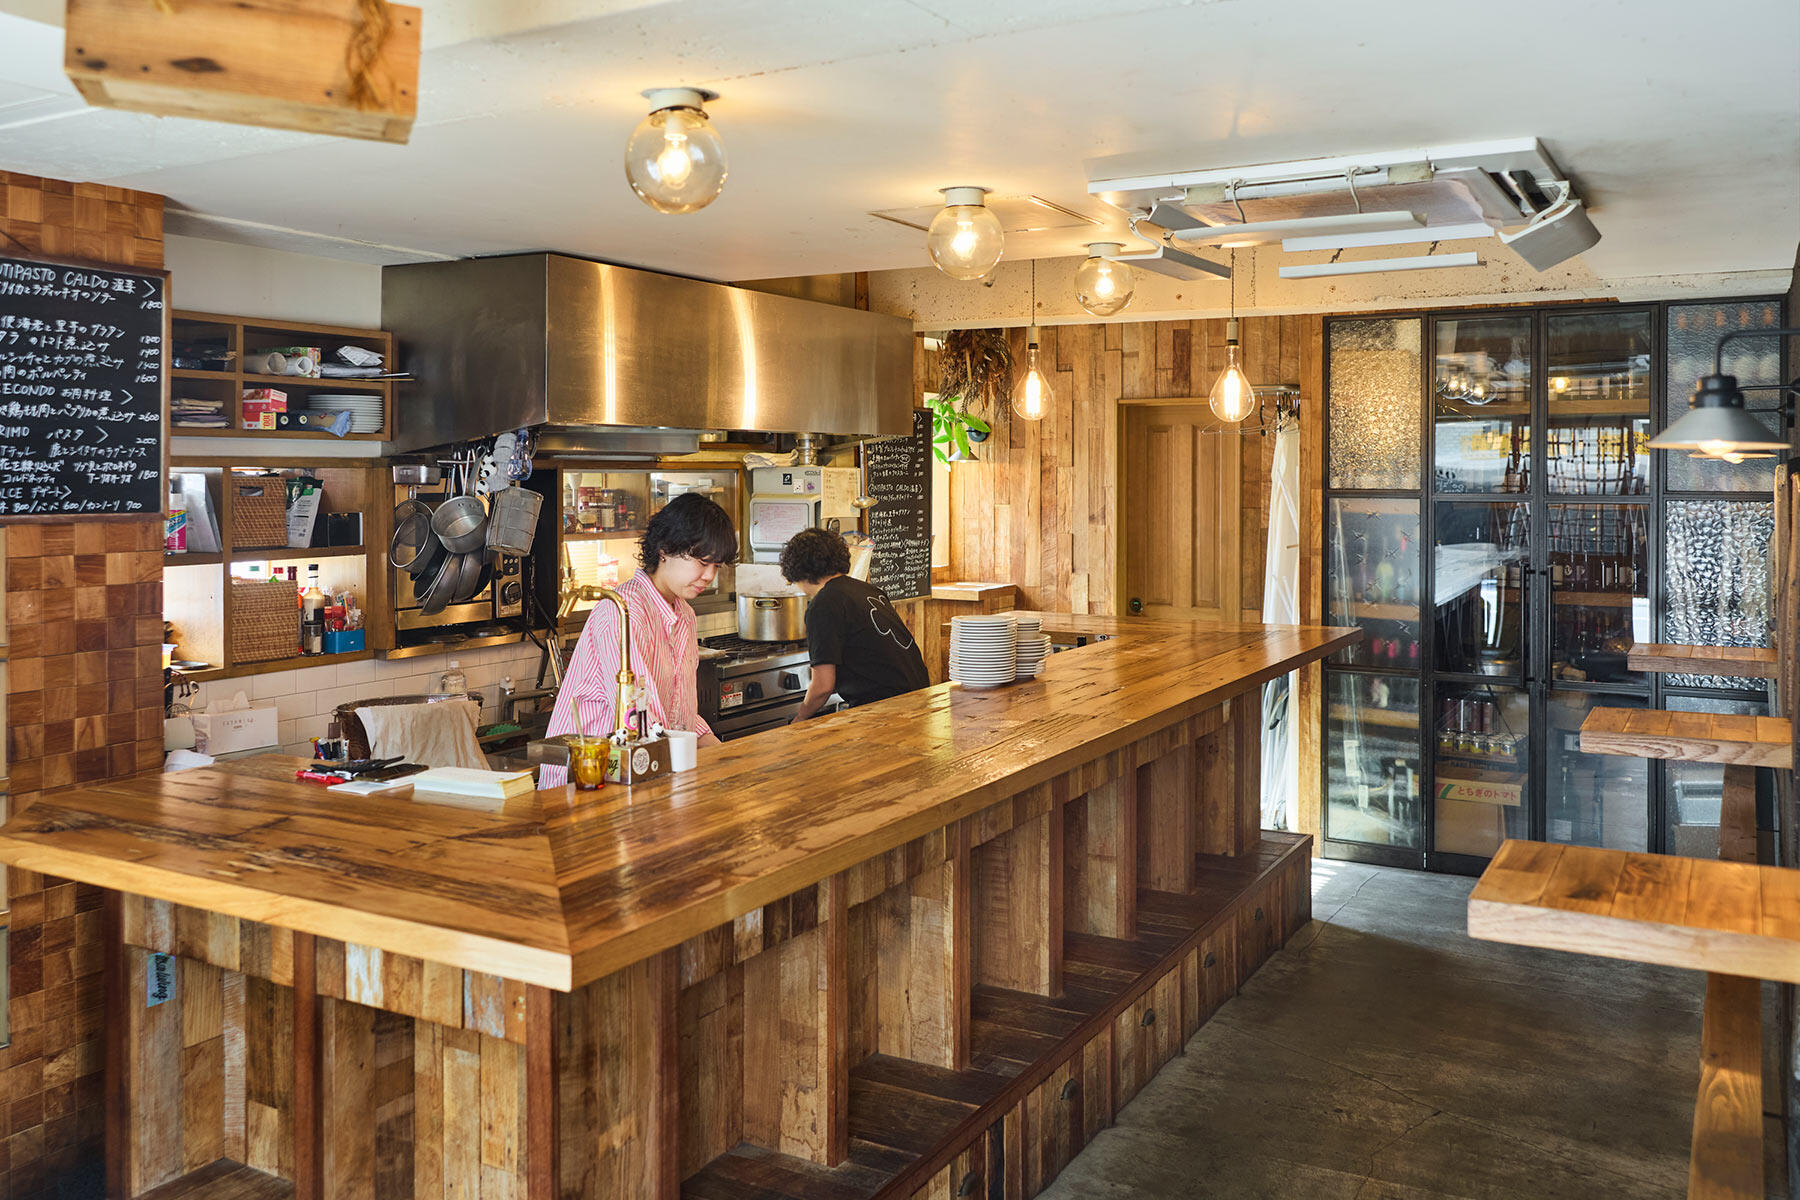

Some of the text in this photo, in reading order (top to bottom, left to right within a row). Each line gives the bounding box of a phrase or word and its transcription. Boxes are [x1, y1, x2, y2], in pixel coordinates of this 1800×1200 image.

[63, 271, 109, 289] CALDO
[139, 300, 163, 311] 1800
[0, 364, 88, 381] 肉のポルペッティ
[134, 374, 158, 384] 1600
[0, 383, 56, 397] ECONDO
[138, 411, 160, 422] 2600
[45, 428, 85, 441] パスタ
[138, 470, 159, 480] 1800
[0, 487, 23, 499] LCE
[1457, 786, 1516, 801] とちぎのトマト
